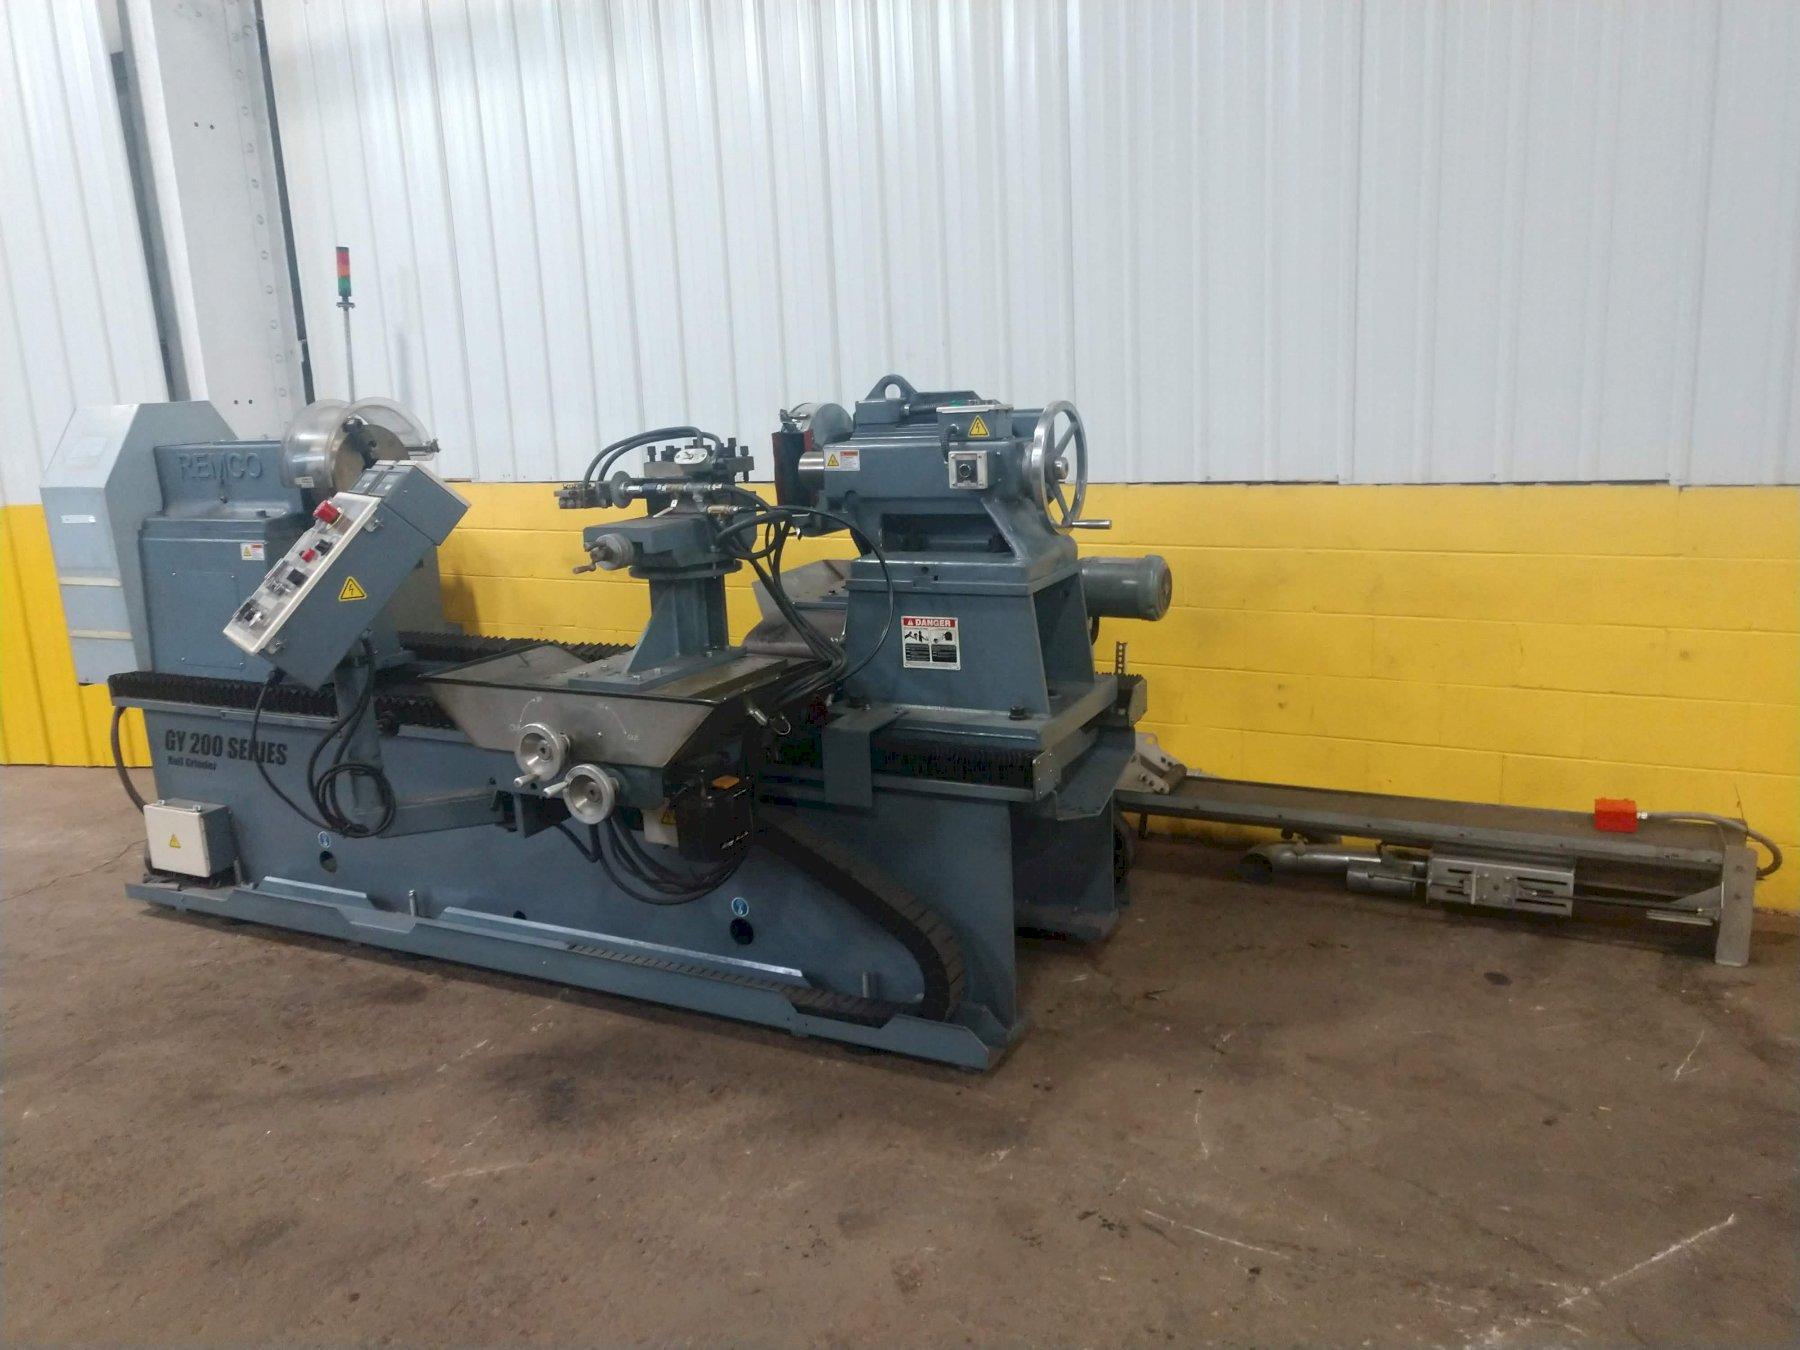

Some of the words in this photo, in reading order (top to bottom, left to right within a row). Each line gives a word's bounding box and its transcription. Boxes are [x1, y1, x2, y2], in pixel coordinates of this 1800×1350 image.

[178, 451, 263, 480] REMCO
[915, 619, 951, 627] DANGER
[165, 728, 186, 752] GY
[189, 732, 223, 757] 200
[227, 736, 288, 765] SERIES
